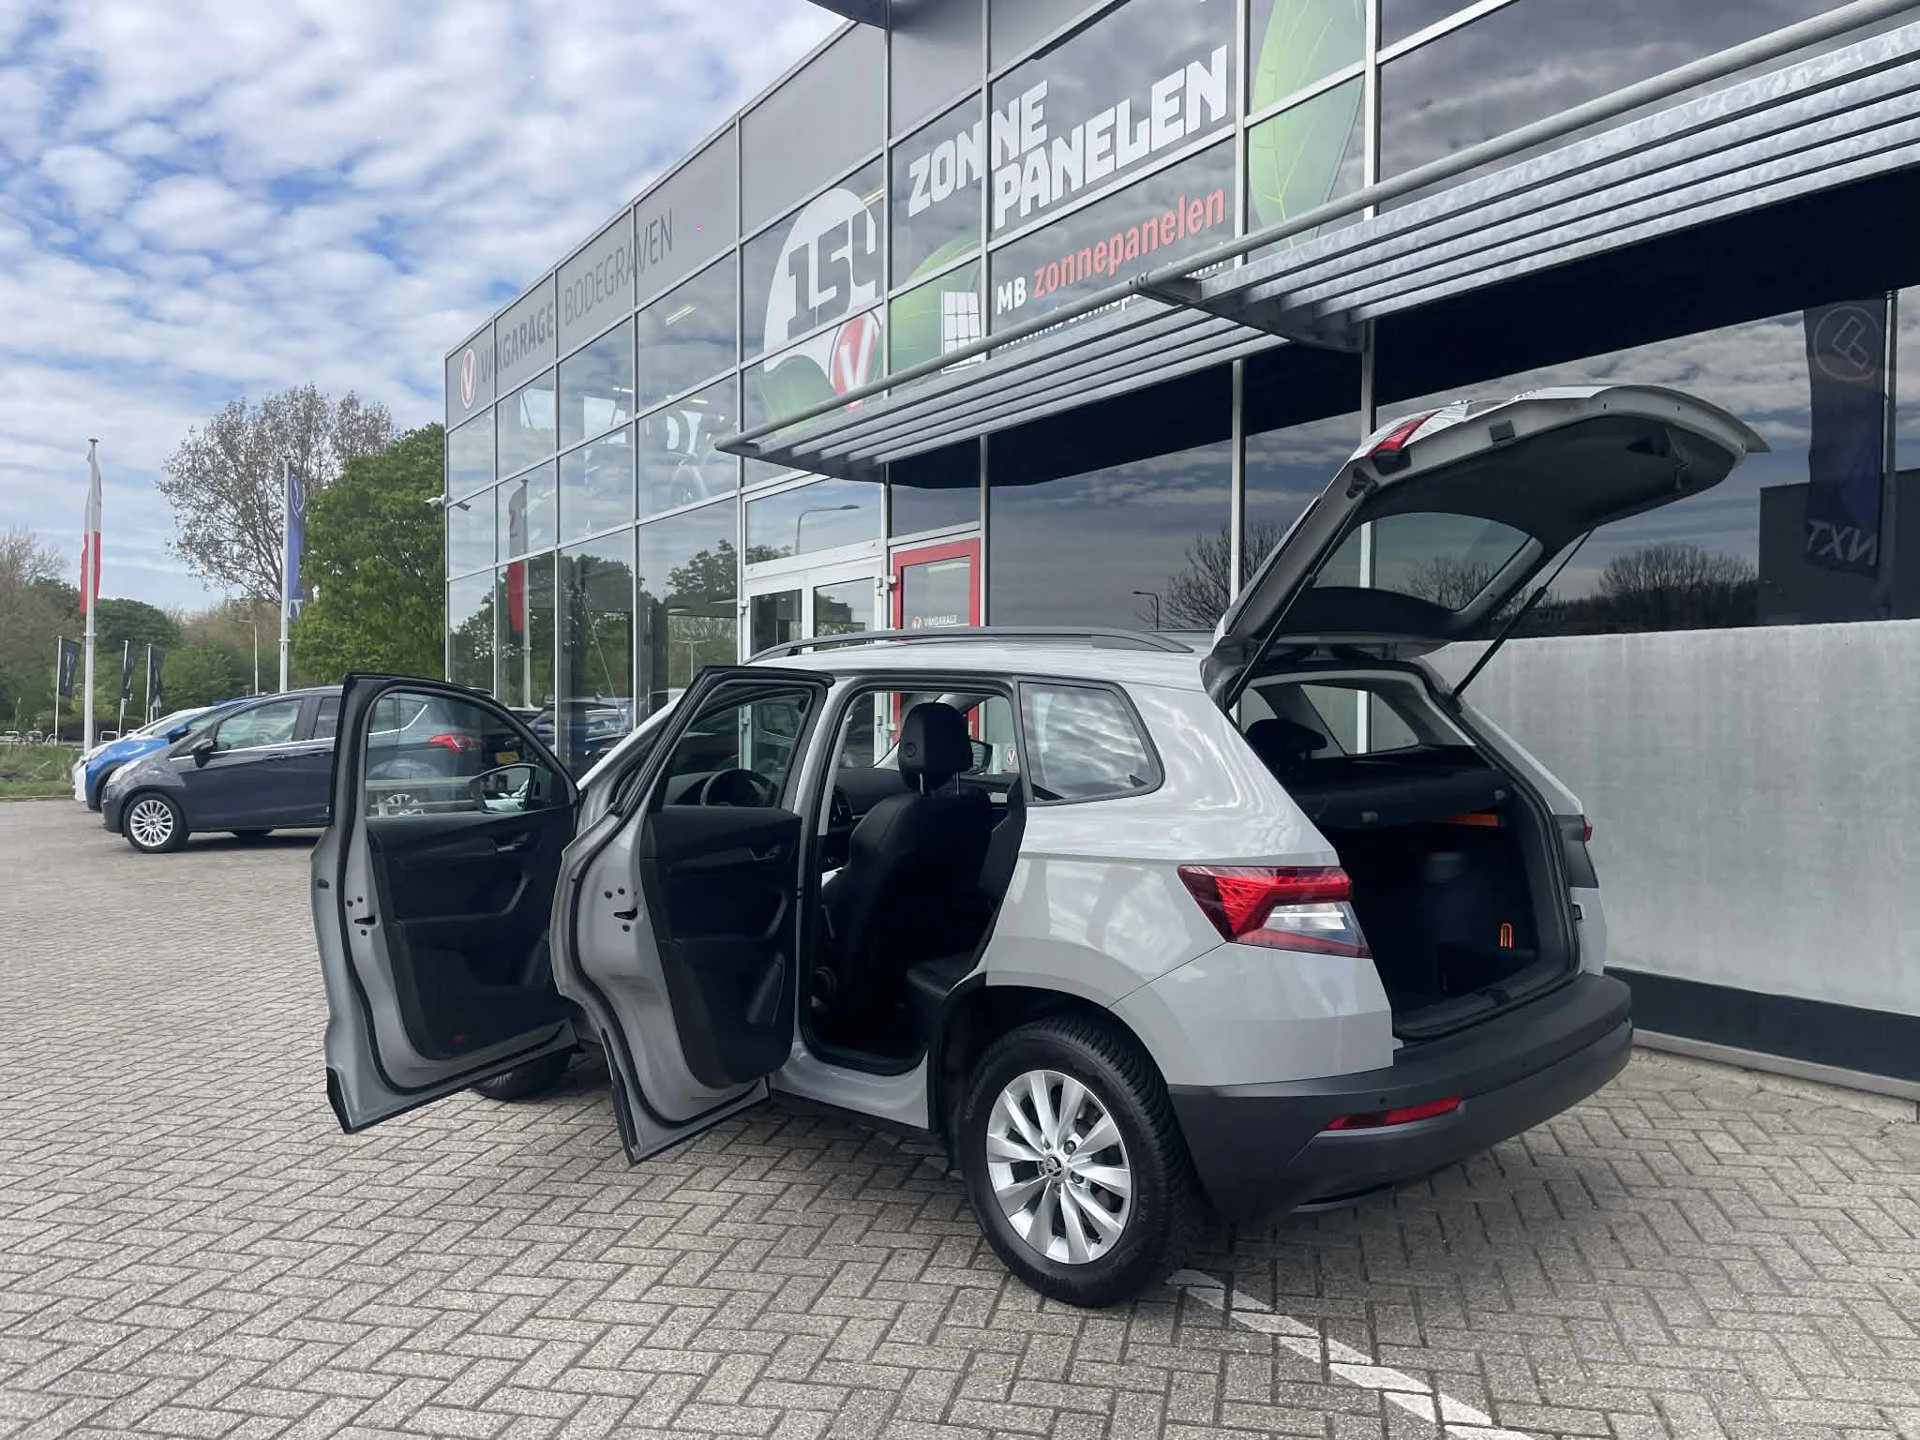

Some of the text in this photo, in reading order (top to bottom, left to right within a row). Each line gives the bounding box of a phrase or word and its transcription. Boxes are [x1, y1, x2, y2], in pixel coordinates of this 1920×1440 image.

[909, 80, 1048, 217] ZONNE
[995, 45, 1228, 230] PANELEN
[564, 208, 673, 328] BODEGRAVEN
[997, 276, 1027, 314] MB
[1033, 188, 1226, 299] zonnepanelen
